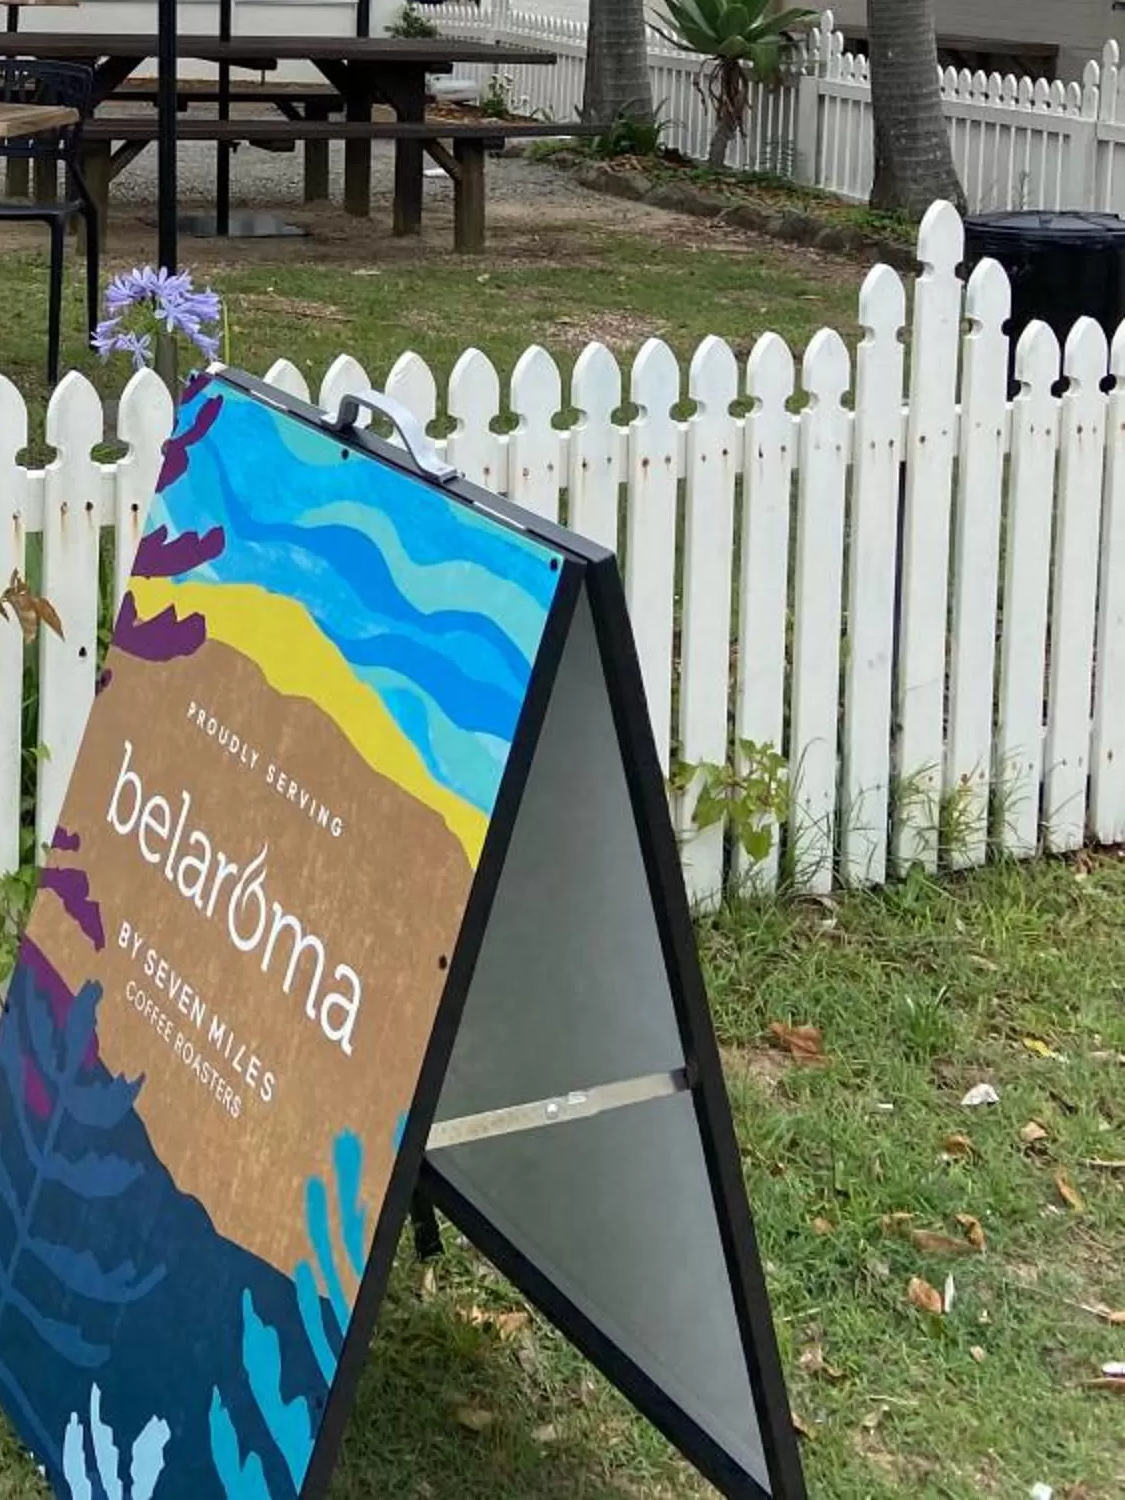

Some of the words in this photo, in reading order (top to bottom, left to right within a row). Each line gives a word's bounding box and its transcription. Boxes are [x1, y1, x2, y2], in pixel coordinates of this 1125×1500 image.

[187, 701, 260, 769] PROUDLY
[266, 764, 343, 837] SERVING
[107, 740, 363, 1056] belaroma
[118, 921, 143, 959] BY
[144, 949, 206, 1029] SEVEN
[208, 1015, 275, 1101] MILES
[126, 980, 174, 1042] COFFEE
[174, 1031, 242, 1118] ROASTERS
